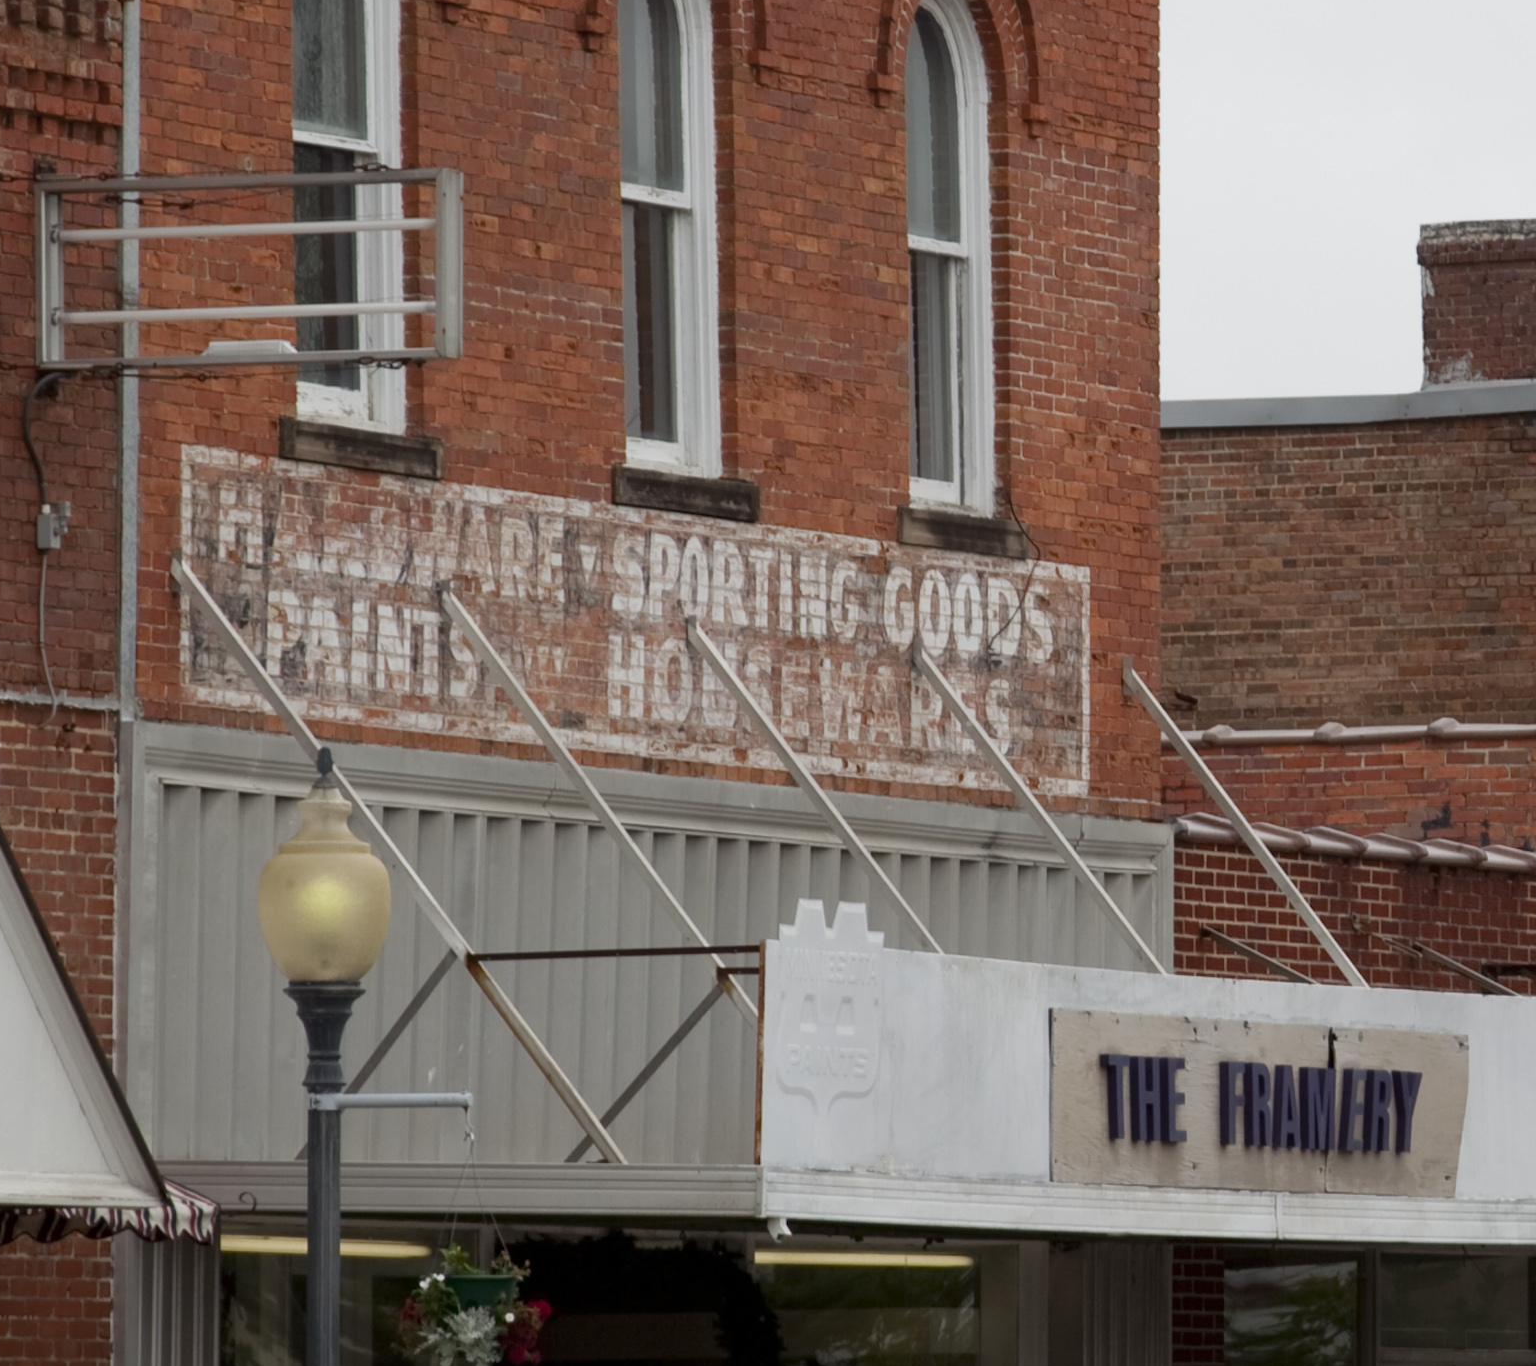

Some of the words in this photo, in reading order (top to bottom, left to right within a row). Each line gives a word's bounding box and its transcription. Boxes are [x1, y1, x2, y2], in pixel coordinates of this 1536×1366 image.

[611, 529, 861, 640] SPORTING
[883, 566, 1055, 664] GOODS
[266, 589, 479, 698] PAINTS
[607, 633, 1013, 756] HOUSEWARES
[1100, 1054, 1187, 1144] THE
[1219, 1059, 1423, 1154] FRAMERY
